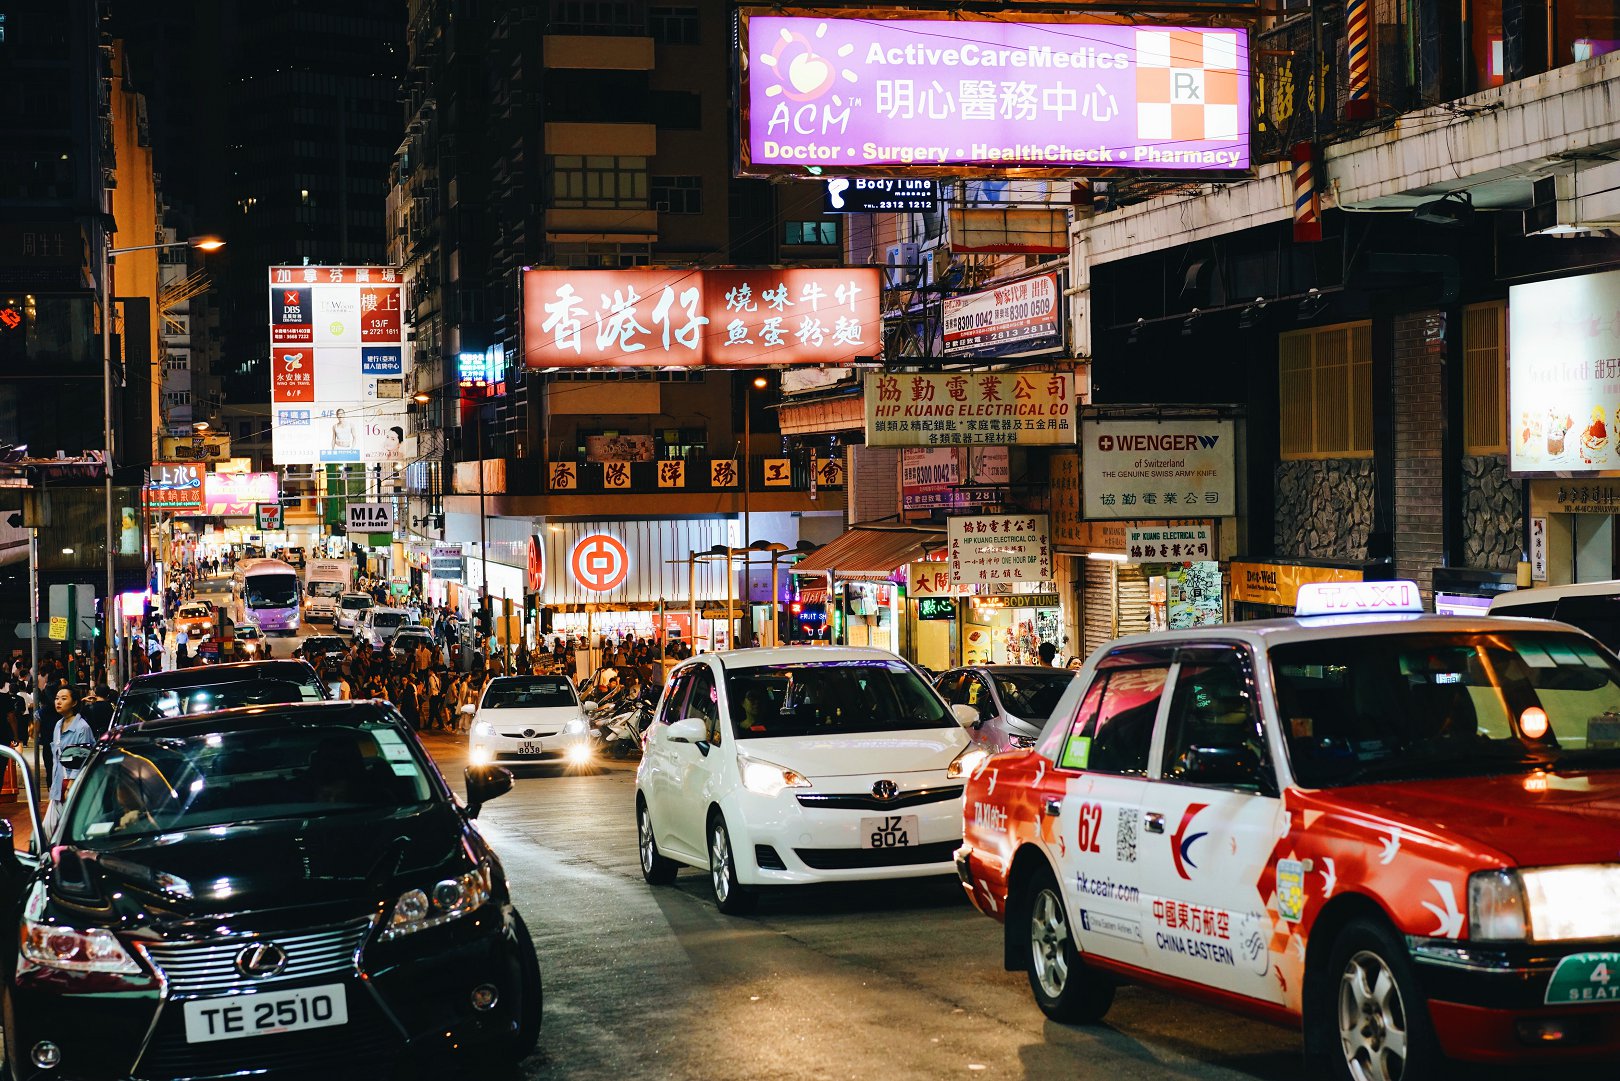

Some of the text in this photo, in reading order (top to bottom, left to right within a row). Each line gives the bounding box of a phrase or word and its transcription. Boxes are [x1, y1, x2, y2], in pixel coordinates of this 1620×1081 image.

[865, 43, 1130, 70] ActiveCareMedics
[876, 79, 1120, 122] 明心醫務中心
[767, 101, 851, 136] ACM
[764, 141, 1241, 168] Doctor Surgery HealthCheck Pharmacy
[880, 201, 904, 209] 2312
[909, 201, 932, 209] 1212
[22, 233, 65, 257] 周生生
[277, 269, 397, 283] 加拿芬廣場
[724, 281, 863, 313] 燒味牛什
[1031, 279, 1049, 299] 出售
[284, 306, 301, 314] DBS
[361, 294, 398, 312] 樓上
[371, 319, 389, 328] 13/F
[541, 283, 709, 354] 香港仔
[957, 313, 974, 332] 8300
[976, 310, 993, 327] 0042
[1009, 302, 1028, 321] 8300
[1030, 297, 1050, 316] 0509
[724, 315, 865, 348] 魚蛋粉麵
[991, 329, 1019, 341] 2813
[1023, 322, 1052, 335] 2811
[277, 373, 311, 381] 永安旅遊
[876, 375, 1067, 403] 協勤電業公司
[875, 403, 1069, 417] HIP KUANG ELECTRICAL CO
[929, 433, 1018, 444] 各類電器工程材料
[1117, 434, 1198, 451] WENGER
[1134, 457, 1185, 468] of Switzerland
[917, 464, 933, 484] 8300
[934, 463, 950, 482] 0042
[1196, 469, 1218, 477] KNIFE
[1101, 491, 1219, 506] 協勤電業公司
[351, 507, 388, 520] MIA
[963, 518, 1036, 534] 協勤電業公司
[973, 537, 993, 545] KUANG
[993, 535, 1027, 544] ELECTRICAL
[1028, 535, 1038, 543] CO.
[1131, 530, 1207, 541] HIP KUANG ELECTRICAL CO.
[1039, 534, 1049, 578] 電器批發
[1130, 542, 1208, 558] 協勤電業公司
[952, 538, 961, 581] 五金用品
[1001, 556, 1012, 565] ONE
[1012, 555, 1027, 565] HOUR
[1004, 597, 1030, 607] BODY
[1032, 596, 1059, 606] TUNE
[1318, 585, 1410, 609] TAXI
[922, 599, 952, 616] 點心
[518, 746, 542, 755] 8038
[524, 741, 536, 749] UL
[877, 816, 903, 832] JZ
[1078, 803, 1103, 853] 62
[871, 830, 909, 848] 804
[1076, 871, 1140, 904] hk.ceair.com
[1153, 899, 1231, 940] 中國東方航空
[1156, 931, 1235, 966] CHINA EASTERN
[1590, 962, 1611, 985] 4
[199, 994, 334, 1036] TE 2510
